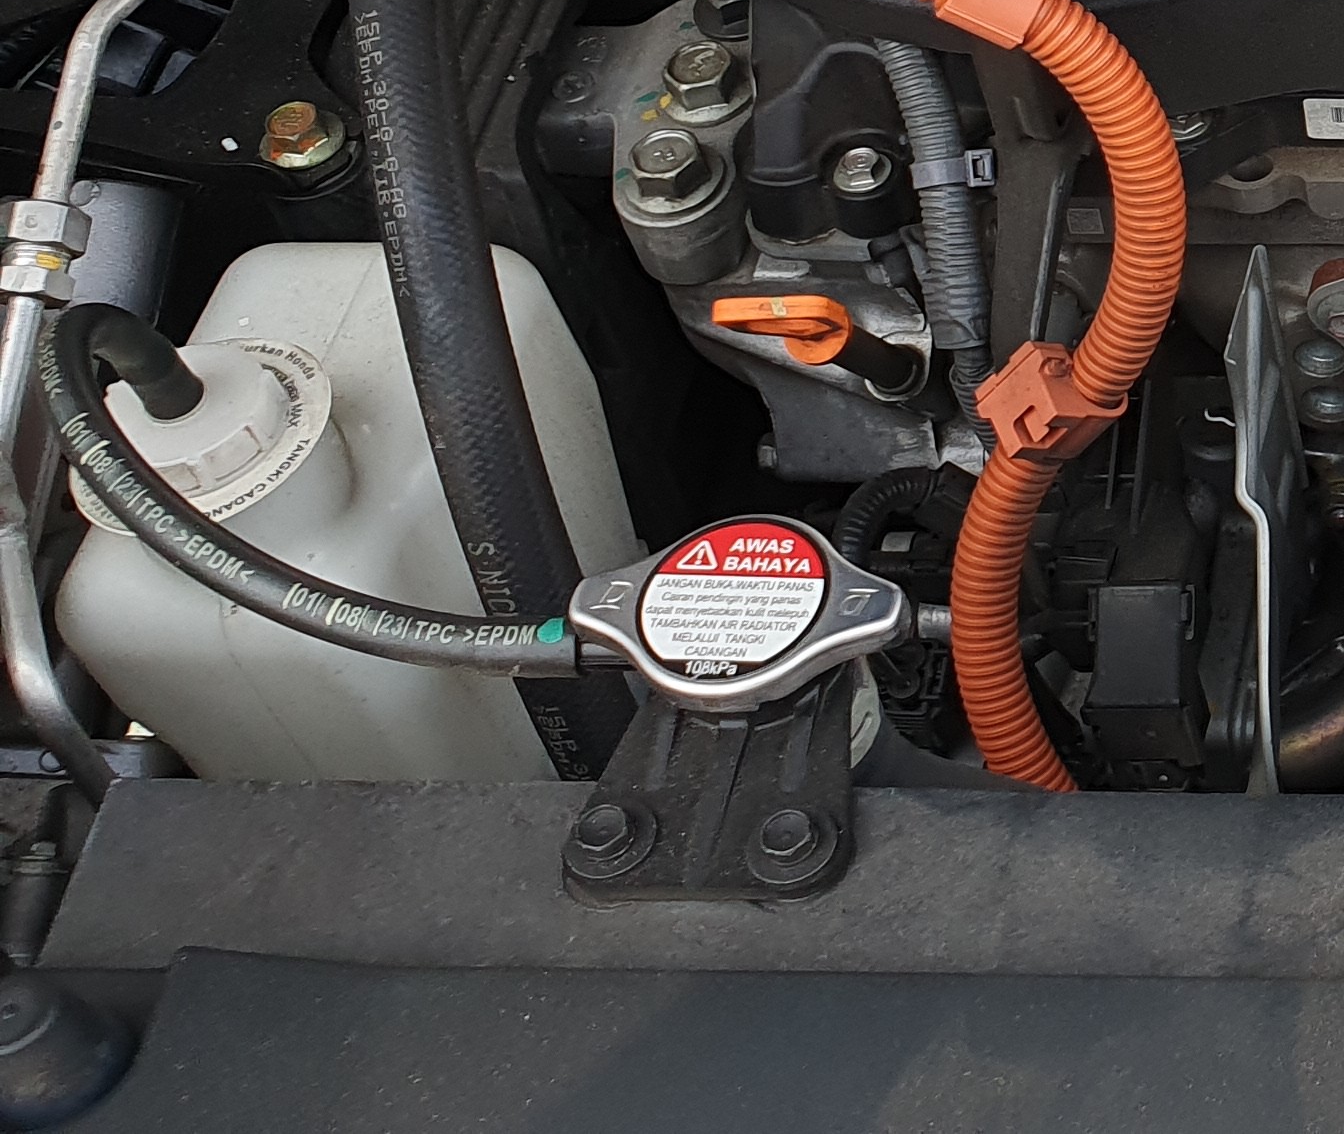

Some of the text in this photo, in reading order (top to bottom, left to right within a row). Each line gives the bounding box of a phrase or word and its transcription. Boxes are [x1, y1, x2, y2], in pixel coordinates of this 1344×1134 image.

[240, 344, 316, 380] urkan Honda
[267, 438, 311, 482] TANGKI
[136, 496, 175, 533] TPC
[729, 538, 795, 554] AWAS
[722, 556, 811, 574] BAHAYA
[656, 578, 702, 589] JANGAN
[734, 580, 775, 591] WAKTU
[777, 581, 815, 592] PANAS
[661, 592, 803, 606] Cairan pendingin yang panas
[645, 606, 673, 616] dapat
[414, 619, 457, 644] TPC
[650, 618, 798, 632] TAMBAHKAN AIR RADIATOR
[725, 634, 767, 644] TANGKI
[684, 646, 748, 657] CADANGAN
[685, 661, 738, 675] 108kPa
